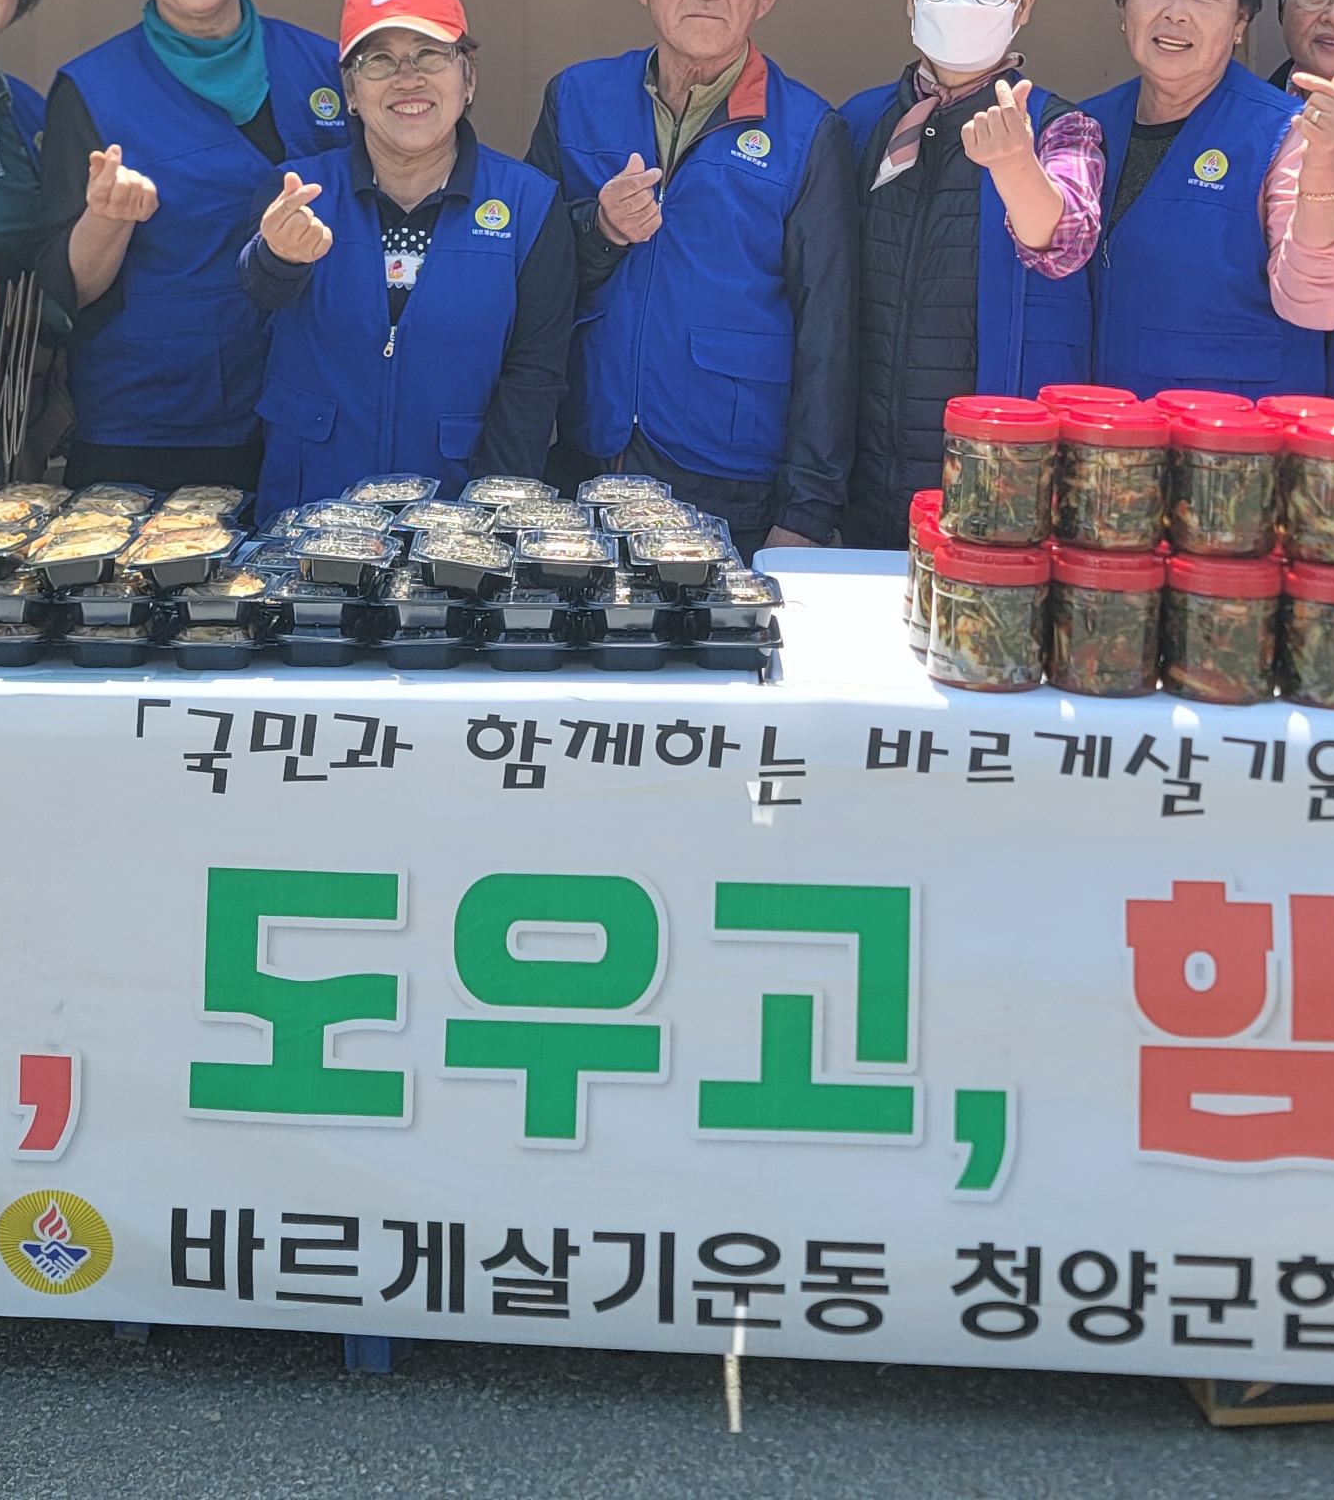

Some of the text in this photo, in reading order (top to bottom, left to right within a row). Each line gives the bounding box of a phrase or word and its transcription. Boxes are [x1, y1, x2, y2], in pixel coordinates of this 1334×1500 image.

[466, 714, 807, 807] 함께하는
[189, 867, 1007, 1190] 도우고,
[170, 1207, 890, 1336] 바르게살기운동
